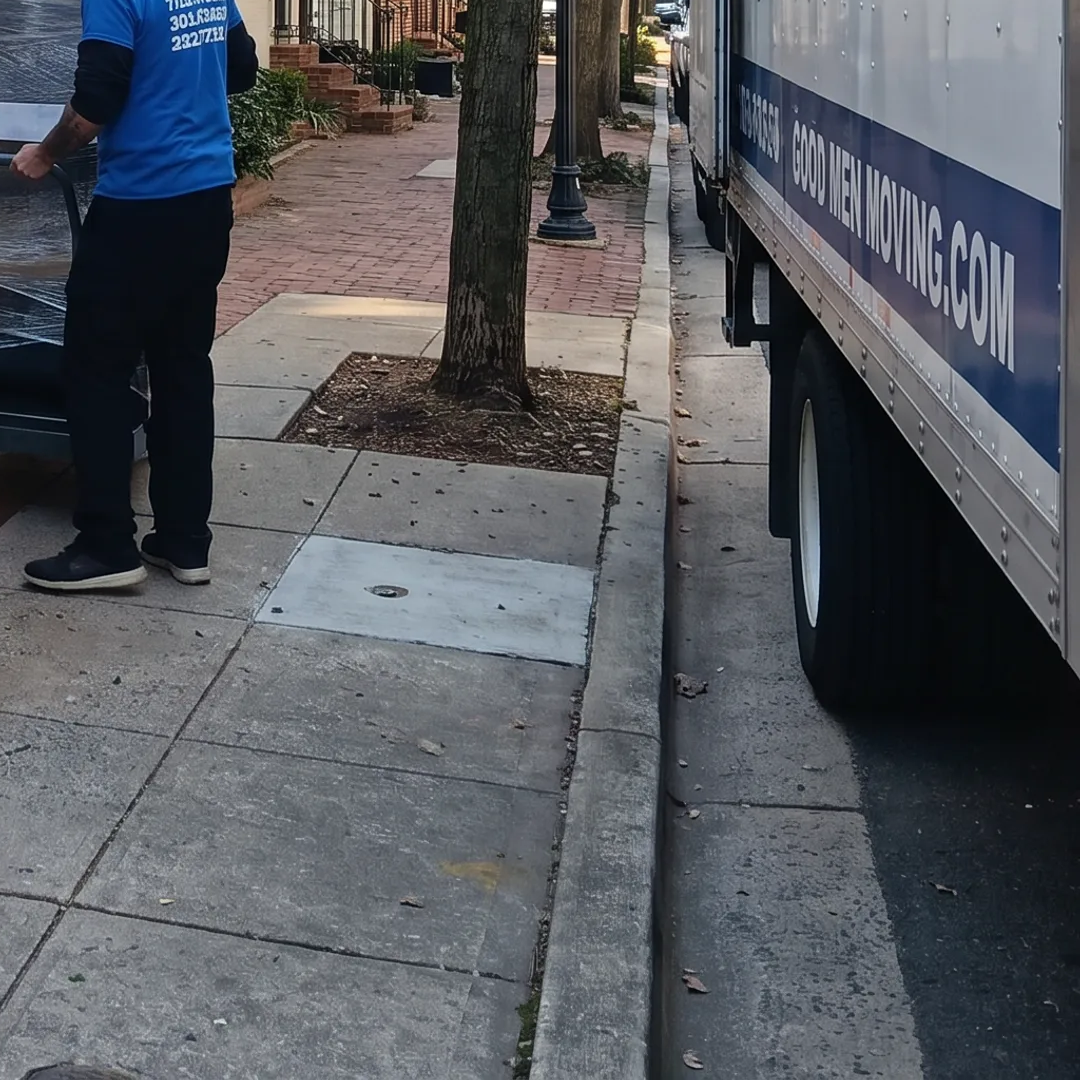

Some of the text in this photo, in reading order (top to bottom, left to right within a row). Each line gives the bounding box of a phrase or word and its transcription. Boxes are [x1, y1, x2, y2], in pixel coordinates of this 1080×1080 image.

[792, 119, 825, 207] GOOD
[829, 140, 862, 239] MEN
[866, 164, 1015, 374] MOVING.COM
